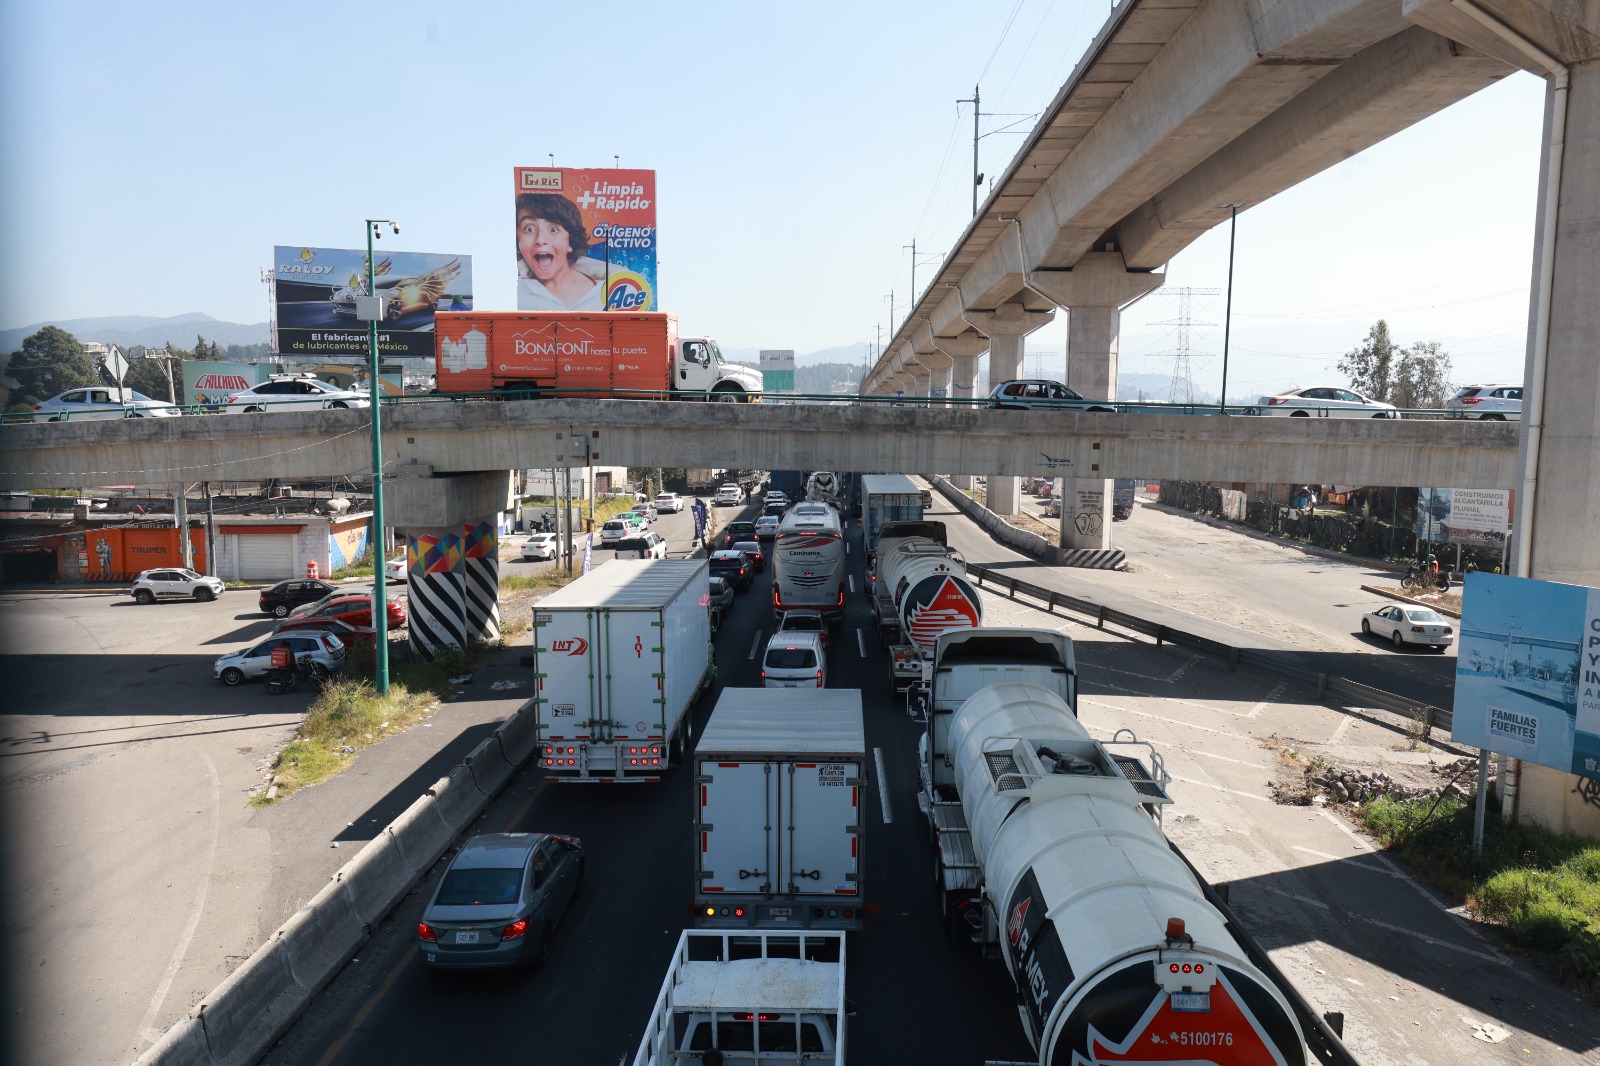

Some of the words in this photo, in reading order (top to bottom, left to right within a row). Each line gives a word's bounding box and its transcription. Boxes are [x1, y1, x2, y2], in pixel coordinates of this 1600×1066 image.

[593, 181, 644, 197] Limpia
[595, 196, 649, 212] Rápido
[593, 224, 651, 237] OXÍGENO
[607, 238, 651, 248] ACTIVO
[279, 264, 335, 275] RALOY
[605, 284, 646, 310] Ace
[311, 333, 322, 341] El
[323, 333, 370, 342] fabricant
[378, 334, 390, 342] #1
[292, 341, 305, 349] de
[307, 341, 360, 350] lubricantes
[378, 341, 409, 351] México
[515, 339, 592, 355] BONAFONT
[590, 348, 611, 356] hasta
[612, 346, 620, 354] tu
[194, 374, 250, 390] CHILCHOTA
[1454, 490, 1504, 500] CONSTRUIMOS
[1453, 497, 1503, 507] ALCANTARILLA
[1453, 505, 1481, 513] PLUVIAL
[131, 546, 167, 554] TRUPER
[552, 640, 575, 652] LNT
[1491, 708, 1537, 729] FAMILIAS
[1490, 719, 1536, 740] FUERTES
[1180, 1031, 1234, 1046] 5100176
